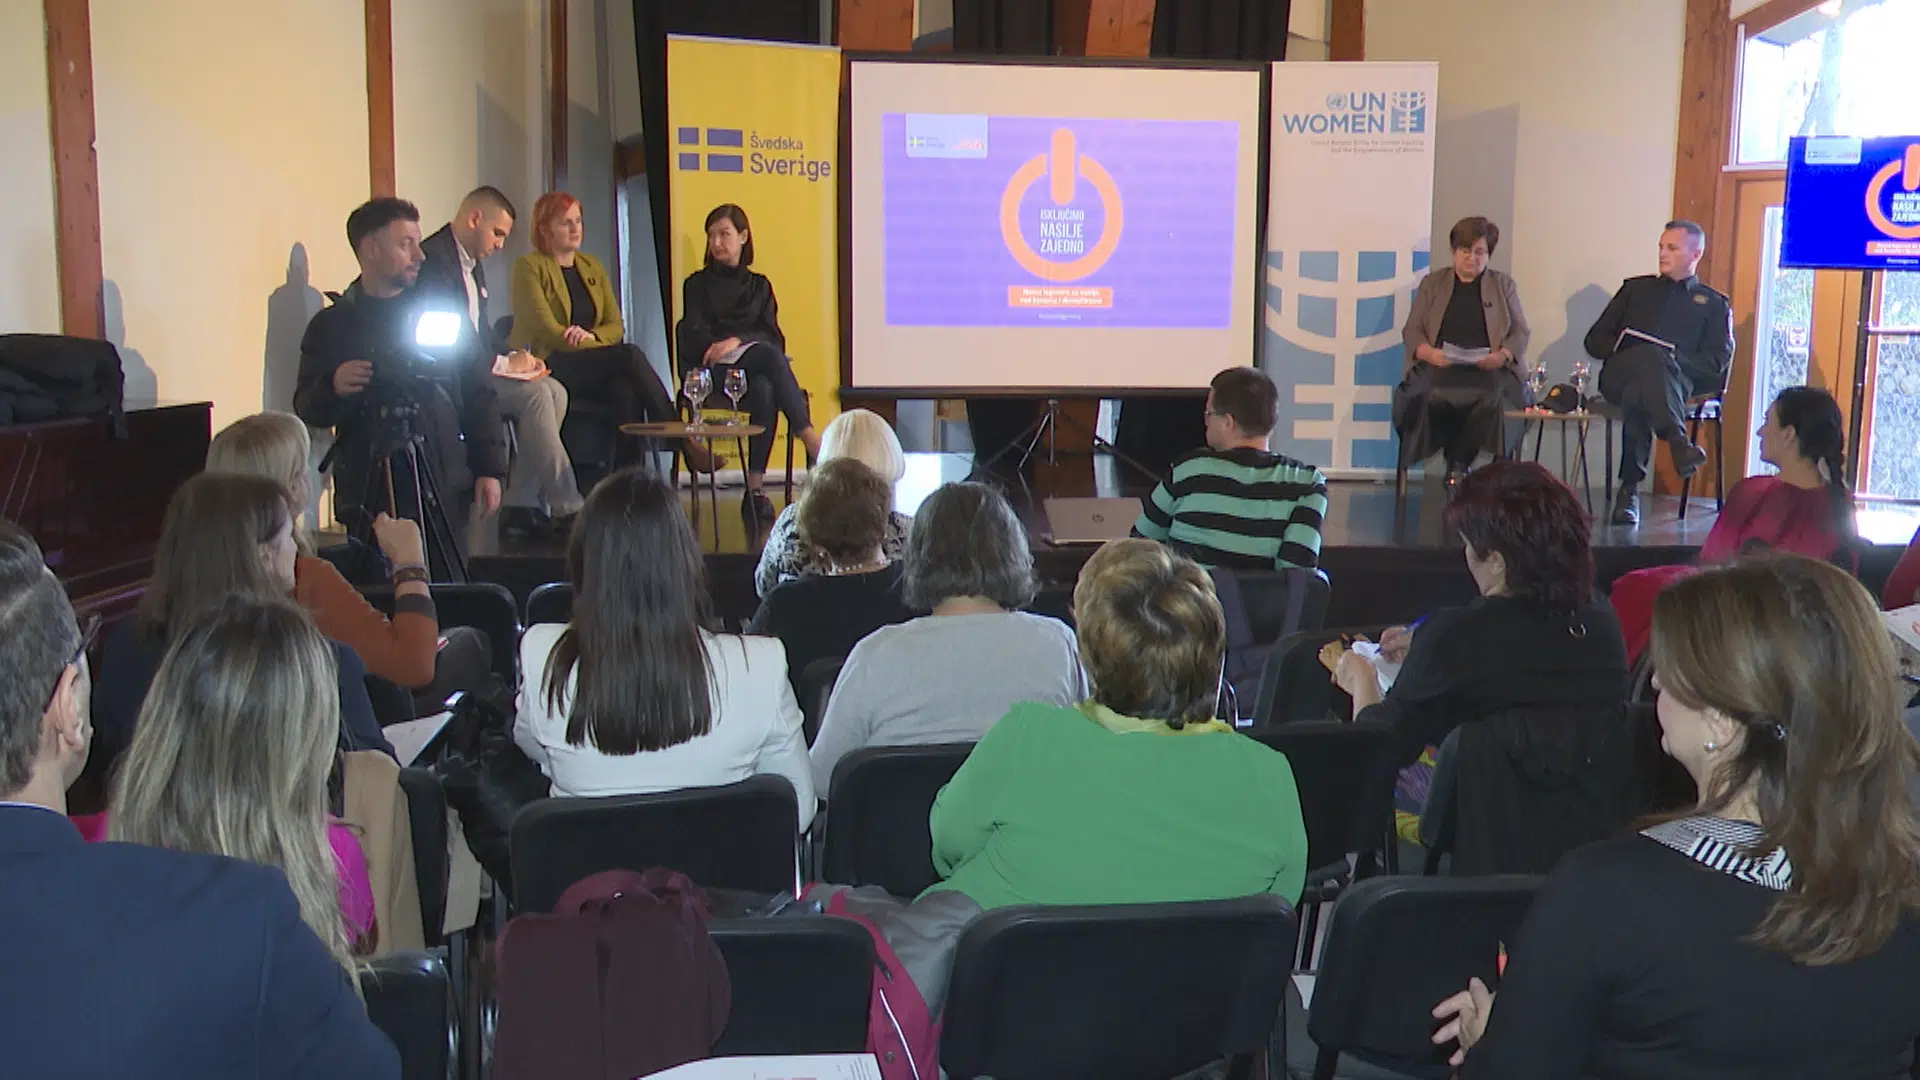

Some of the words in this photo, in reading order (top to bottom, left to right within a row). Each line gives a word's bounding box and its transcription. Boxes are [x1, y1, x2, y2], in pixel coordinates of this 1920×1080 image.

[1350, 92, 1386, 112] UN
[1282, 113, 1385, 134] WOMEN
[750, 131, 803, 150] Švedska
[750, 152, 831, 182] Sverige
[1040, 222, 1084, 239] NASILJE
[1040, 239, 1084, 254] ZAJEDNO
